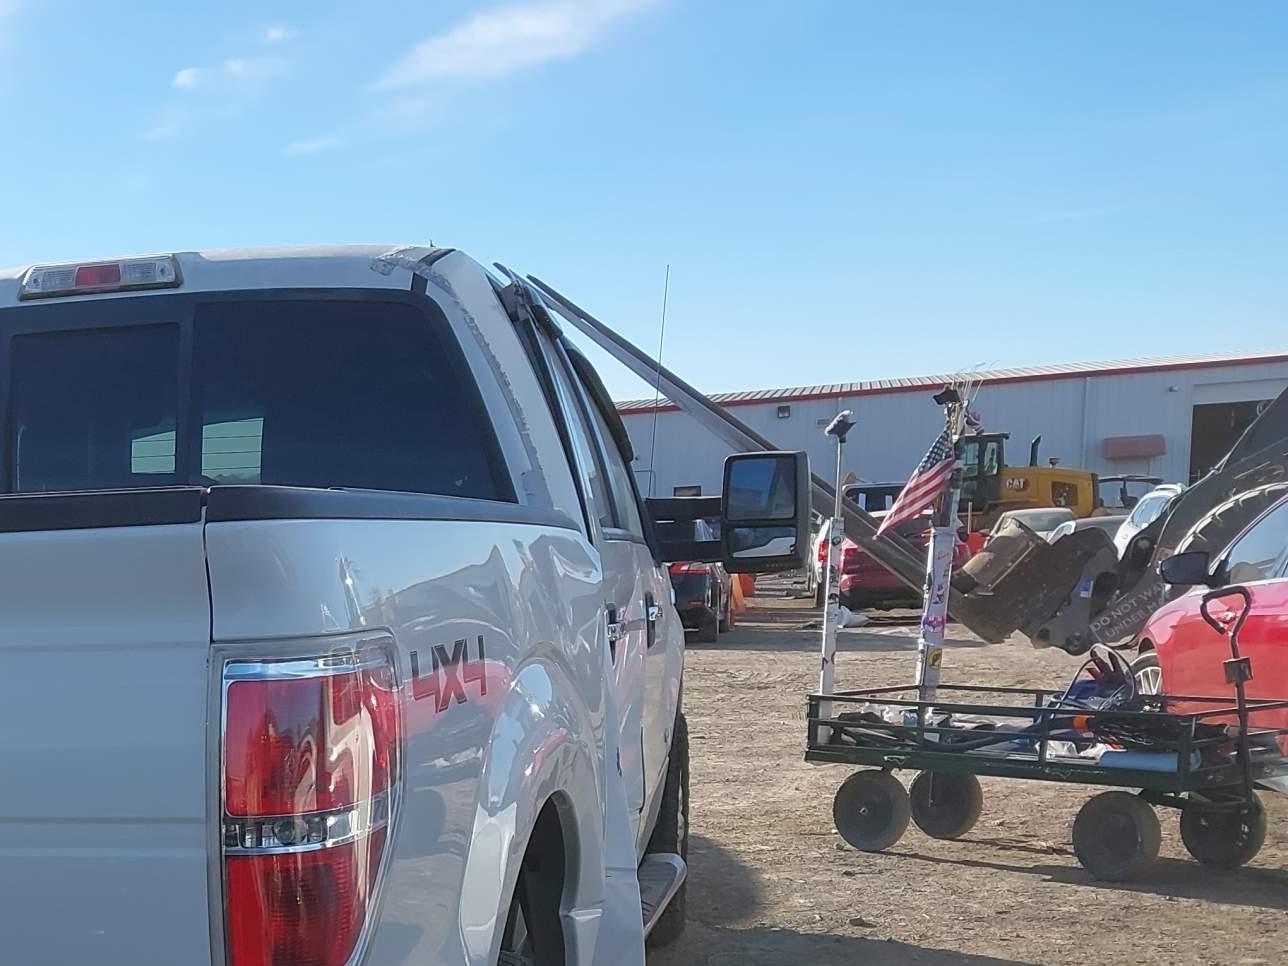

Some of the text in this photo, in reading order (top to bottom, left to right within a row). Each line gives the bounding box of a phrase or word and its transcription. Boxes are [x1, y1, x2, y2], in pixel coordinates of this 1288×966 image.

[1006, 478, 1025, 489] CAT
[1089, 615, 1111, 633] DO
[1111, 598, 1138, 619] NOT
